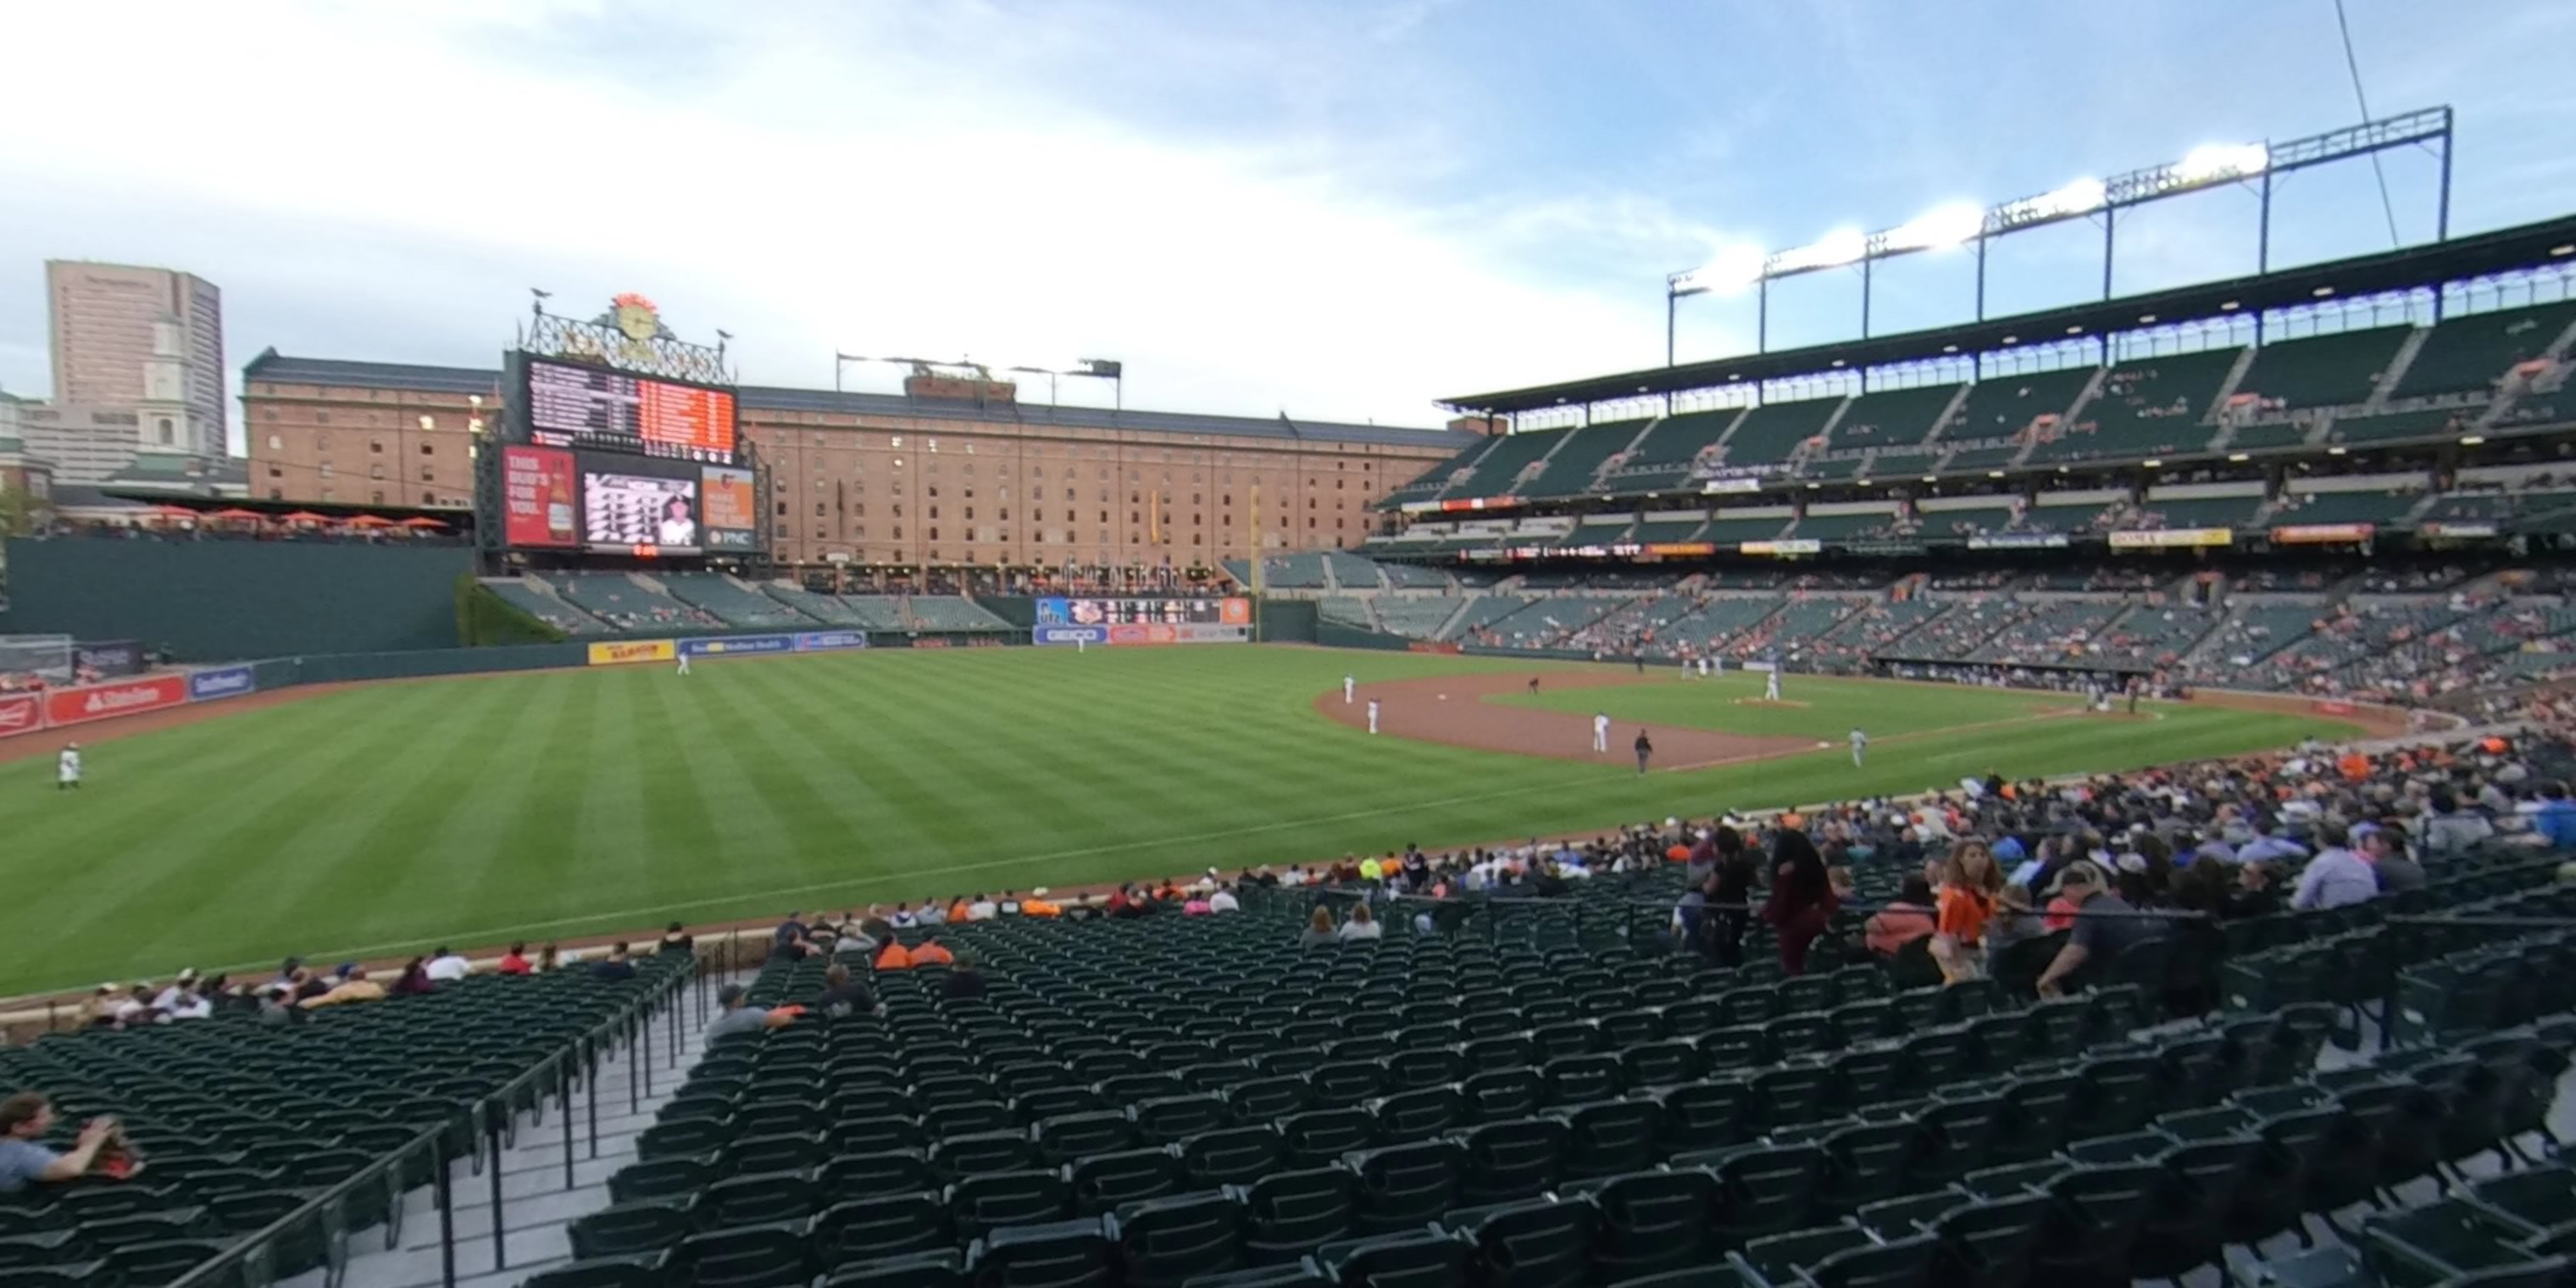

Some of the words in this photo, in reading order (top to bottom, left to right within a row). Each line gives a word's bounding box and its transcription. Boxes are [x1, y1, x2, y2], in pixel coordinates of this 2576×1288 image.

[508, 456, 539, 470] THIS
[508, 470, 548, 486] BUD'S
[509, 485, 536, 499] FOR
[723, 531, 749, 545] PNC
[1046, 630, 1096, 641] GEICO
